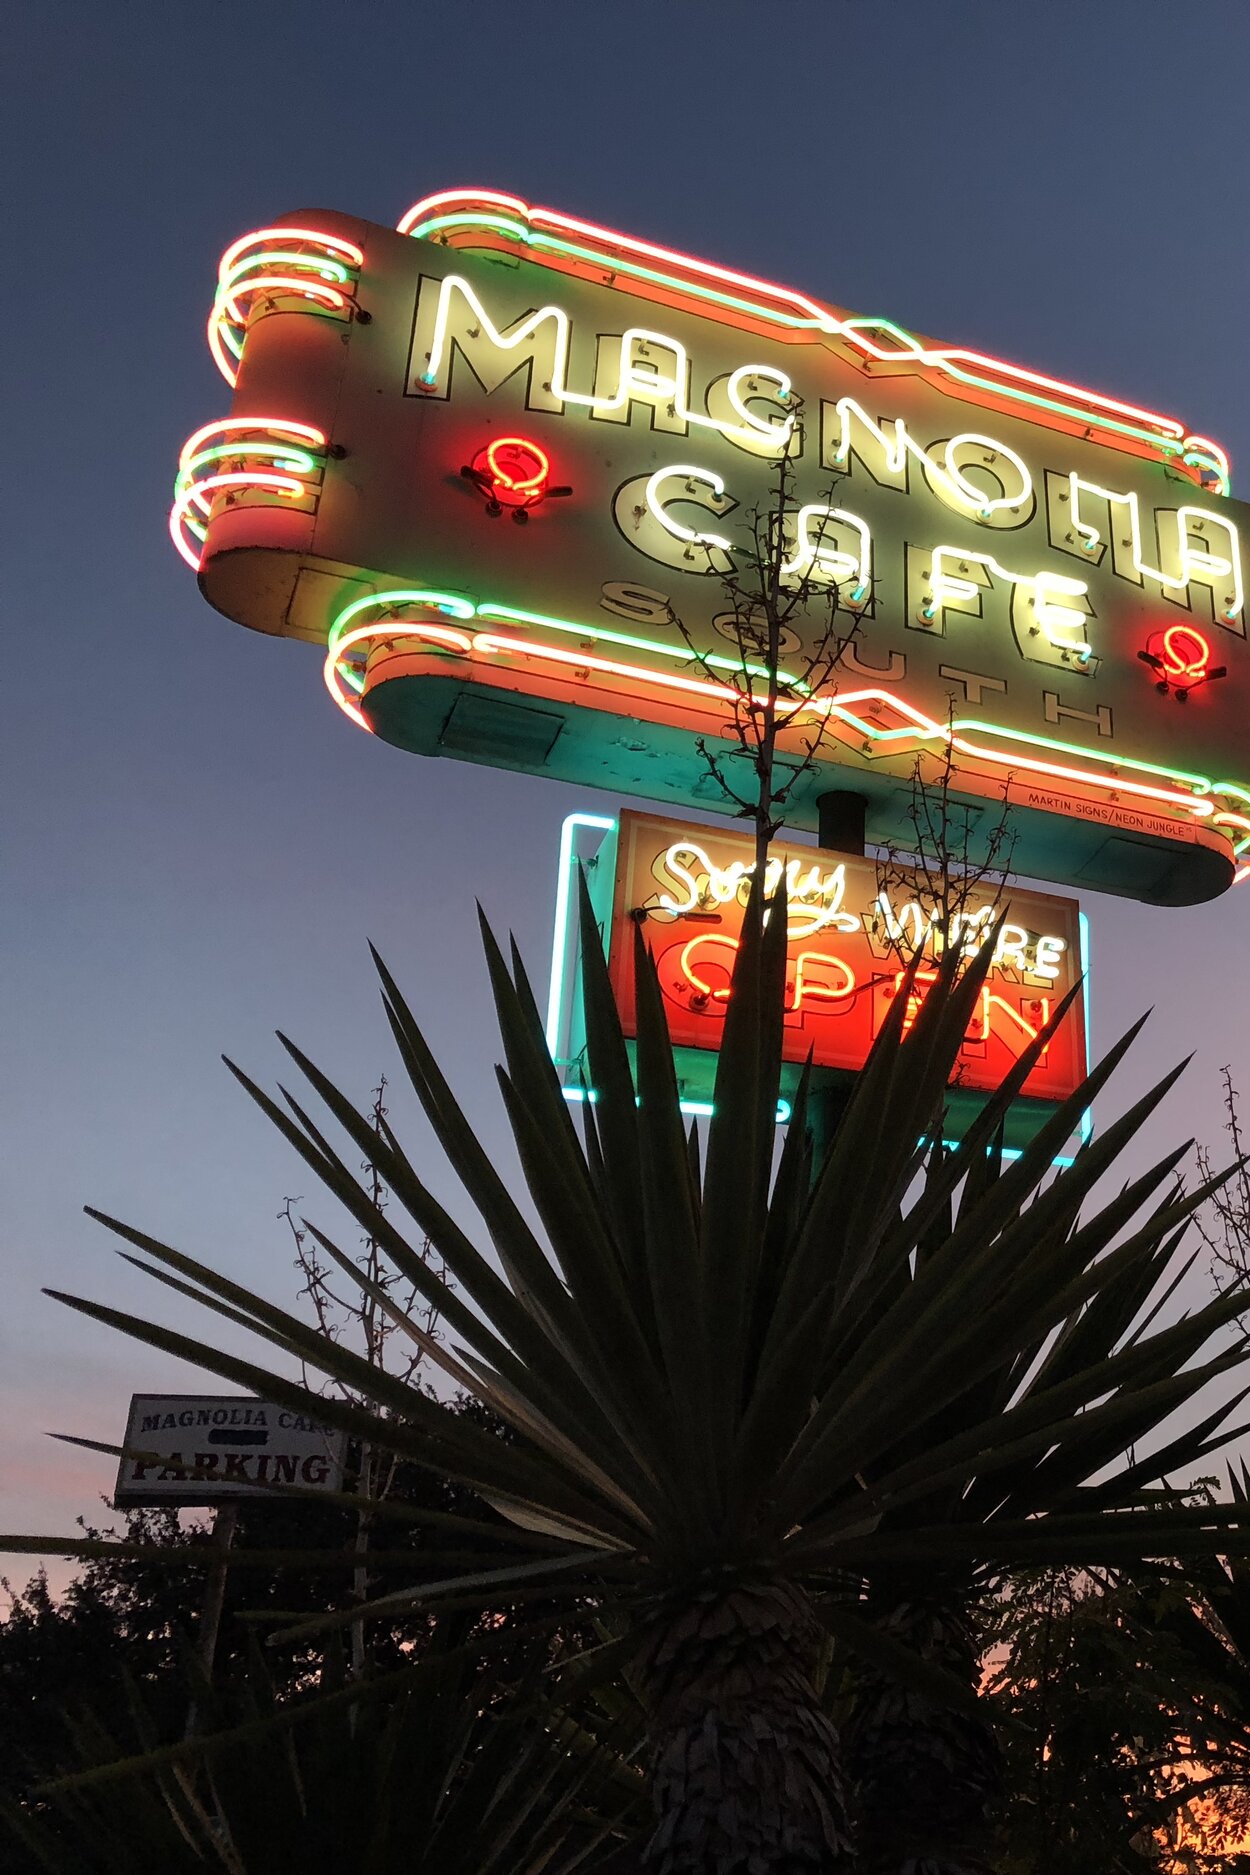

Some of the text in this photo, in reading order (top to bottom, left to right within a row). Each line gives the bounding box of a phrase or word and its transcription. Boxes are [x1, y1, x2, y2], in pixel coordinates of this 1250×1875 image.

[404, 274, 1247, 640] MAGNOLIA
[612, 464, 1103, 679] CAFE
[600, 579, 1114, 738] SOUTH
[1028, 792, 1072, 811] MARTIN
[1146, 821, 1185, 837] JUNGLE
[131, 1451, 332, 1485] PARKING
[140, 1408, 268, 1433] MAGNOLIA
